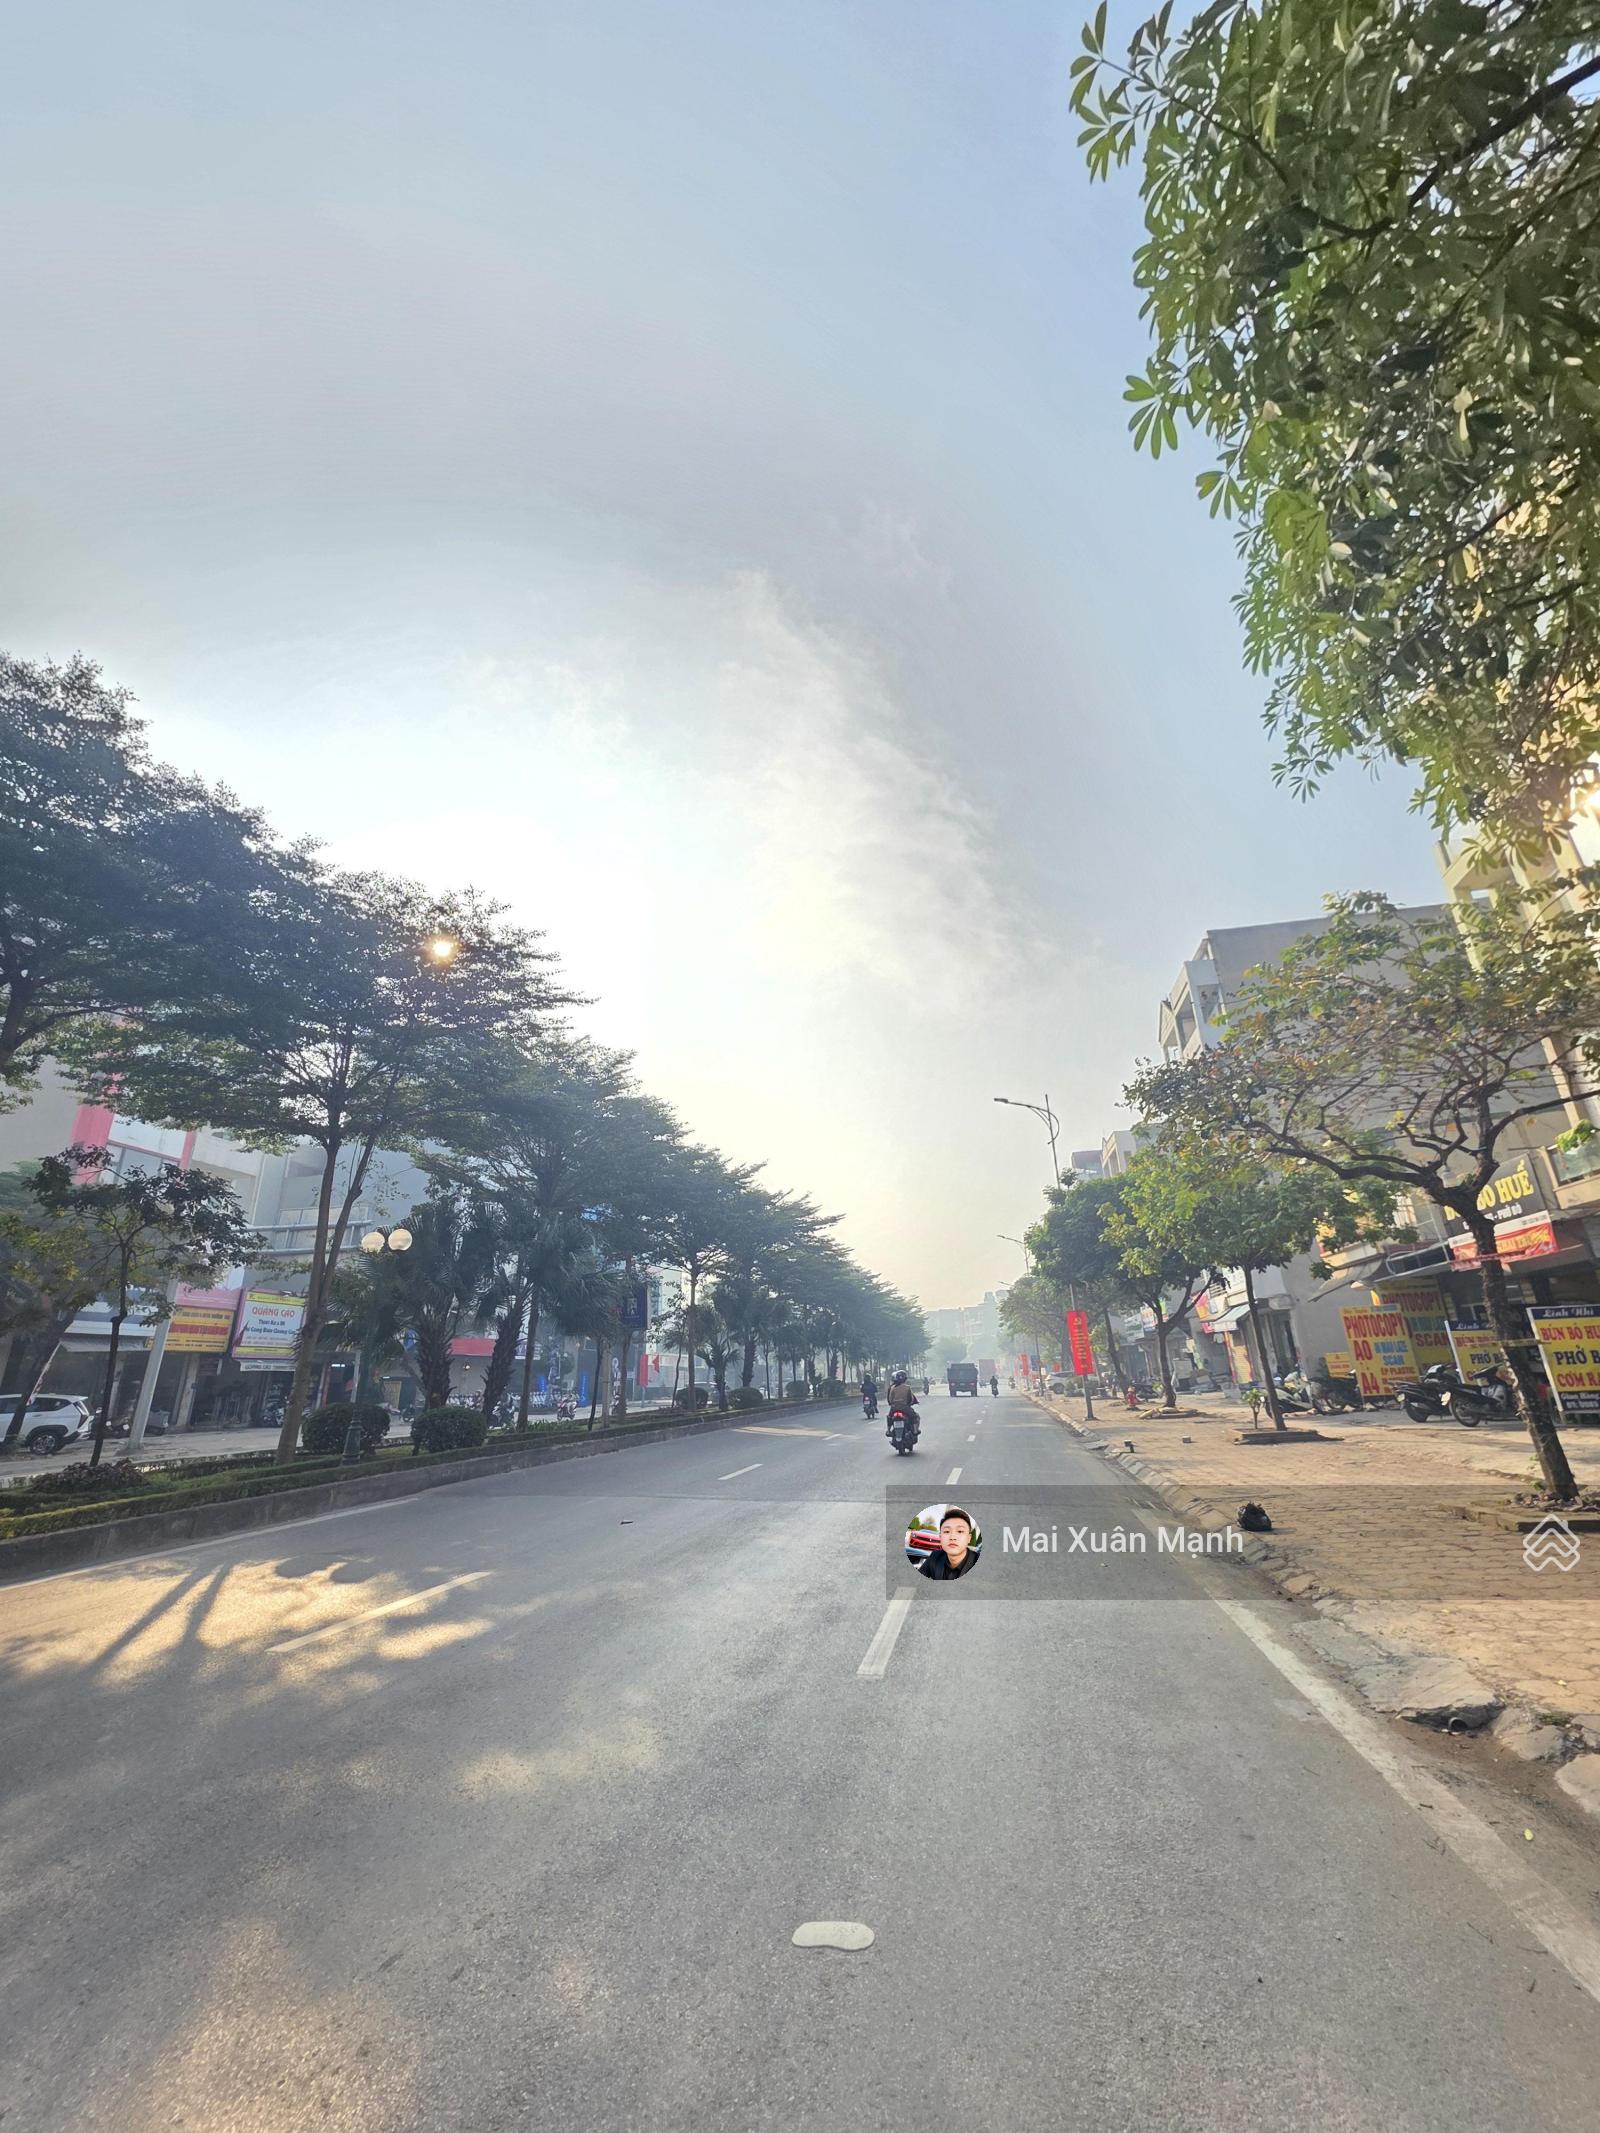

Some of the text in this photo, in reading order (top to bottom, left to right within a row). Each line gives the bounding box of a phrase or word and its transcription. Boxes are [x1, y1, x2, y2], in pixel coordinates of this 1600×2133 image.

[1495, 1159, 1535, 1203] HUẾ
[1344, 1312, 1406, 1339] PHOTOCOPY
[1554, 1345, 1587, 1365] PHỞ
[1361, 1372, 1380, 1394] A4
